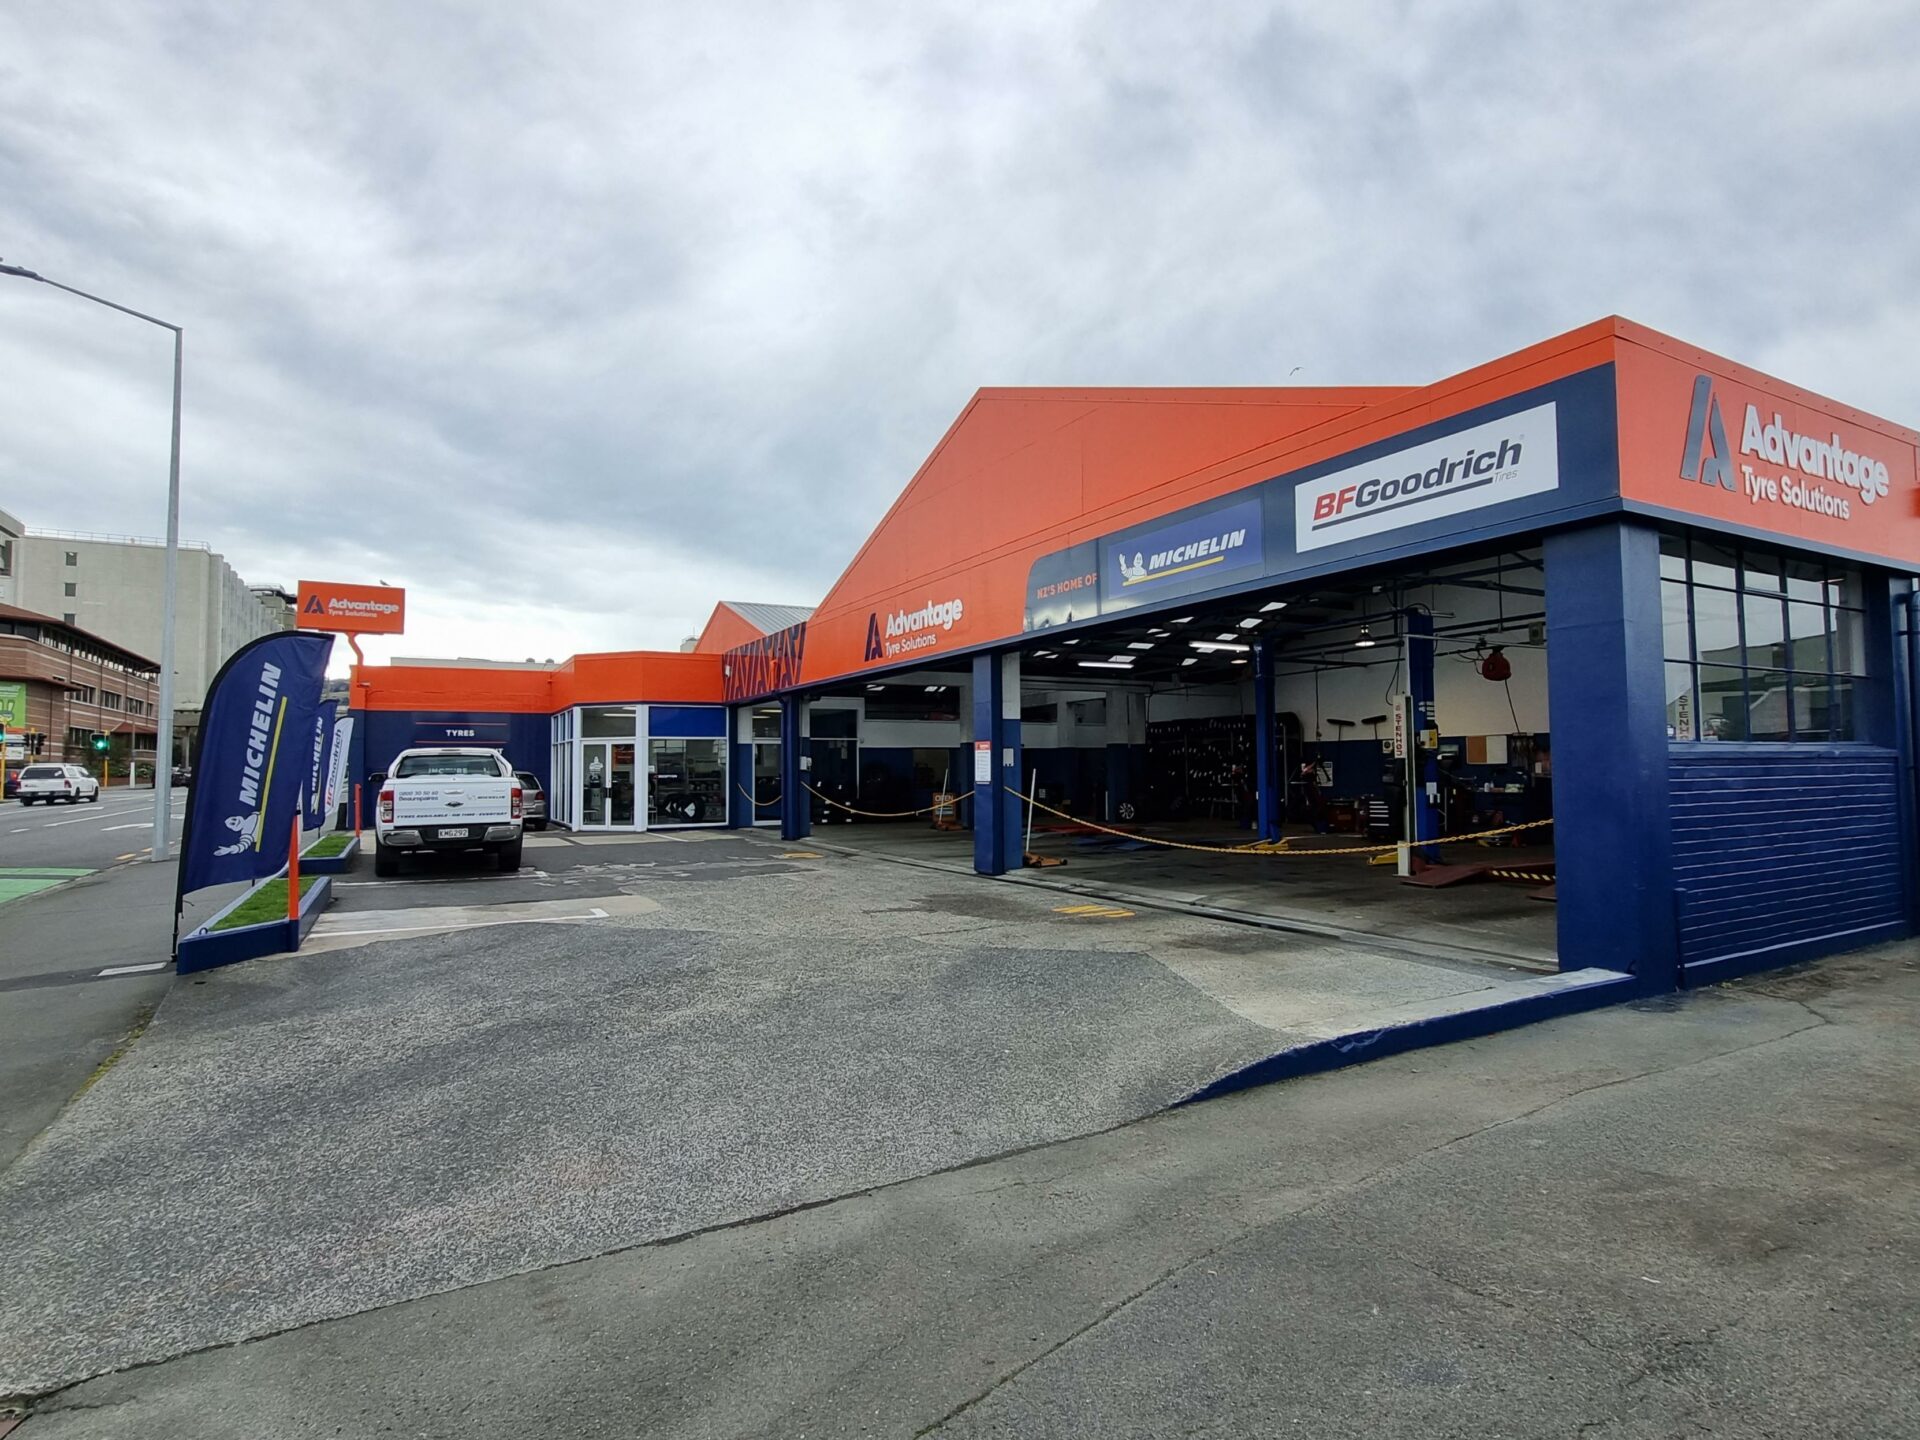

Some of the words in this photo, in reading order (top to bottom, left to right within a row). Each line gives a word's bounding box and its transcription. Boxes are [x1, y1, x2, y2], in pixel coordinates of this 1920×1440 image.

[1740, 403, 1890, 505] Advantage
[1313, 439, 1523, 521] BFGoodrich
[1494, 469, 1518, 484] Tires
[1740, 463, 1778, 504] Tyre
[1779, 475, 1850, 520] Solutions
[1149, 528, 1246, 571] MICHELIN
[1037, 584, 1056, 599] NZ'S
[1057, 577, 1083, 594] HOME
[1085, 572, 1098, 585] OF
[328, 598, 400, 614] Advantage
[344, 610, 377, 618] Solutions
[885, 599, 963, 639] Advantage
[885, 642, 901, 658] Tyre
[901, 634, 937, 652] Solutions
[239, 662, 281, 807] MICHELIN
[446, 729, 475, 737] TYRES
